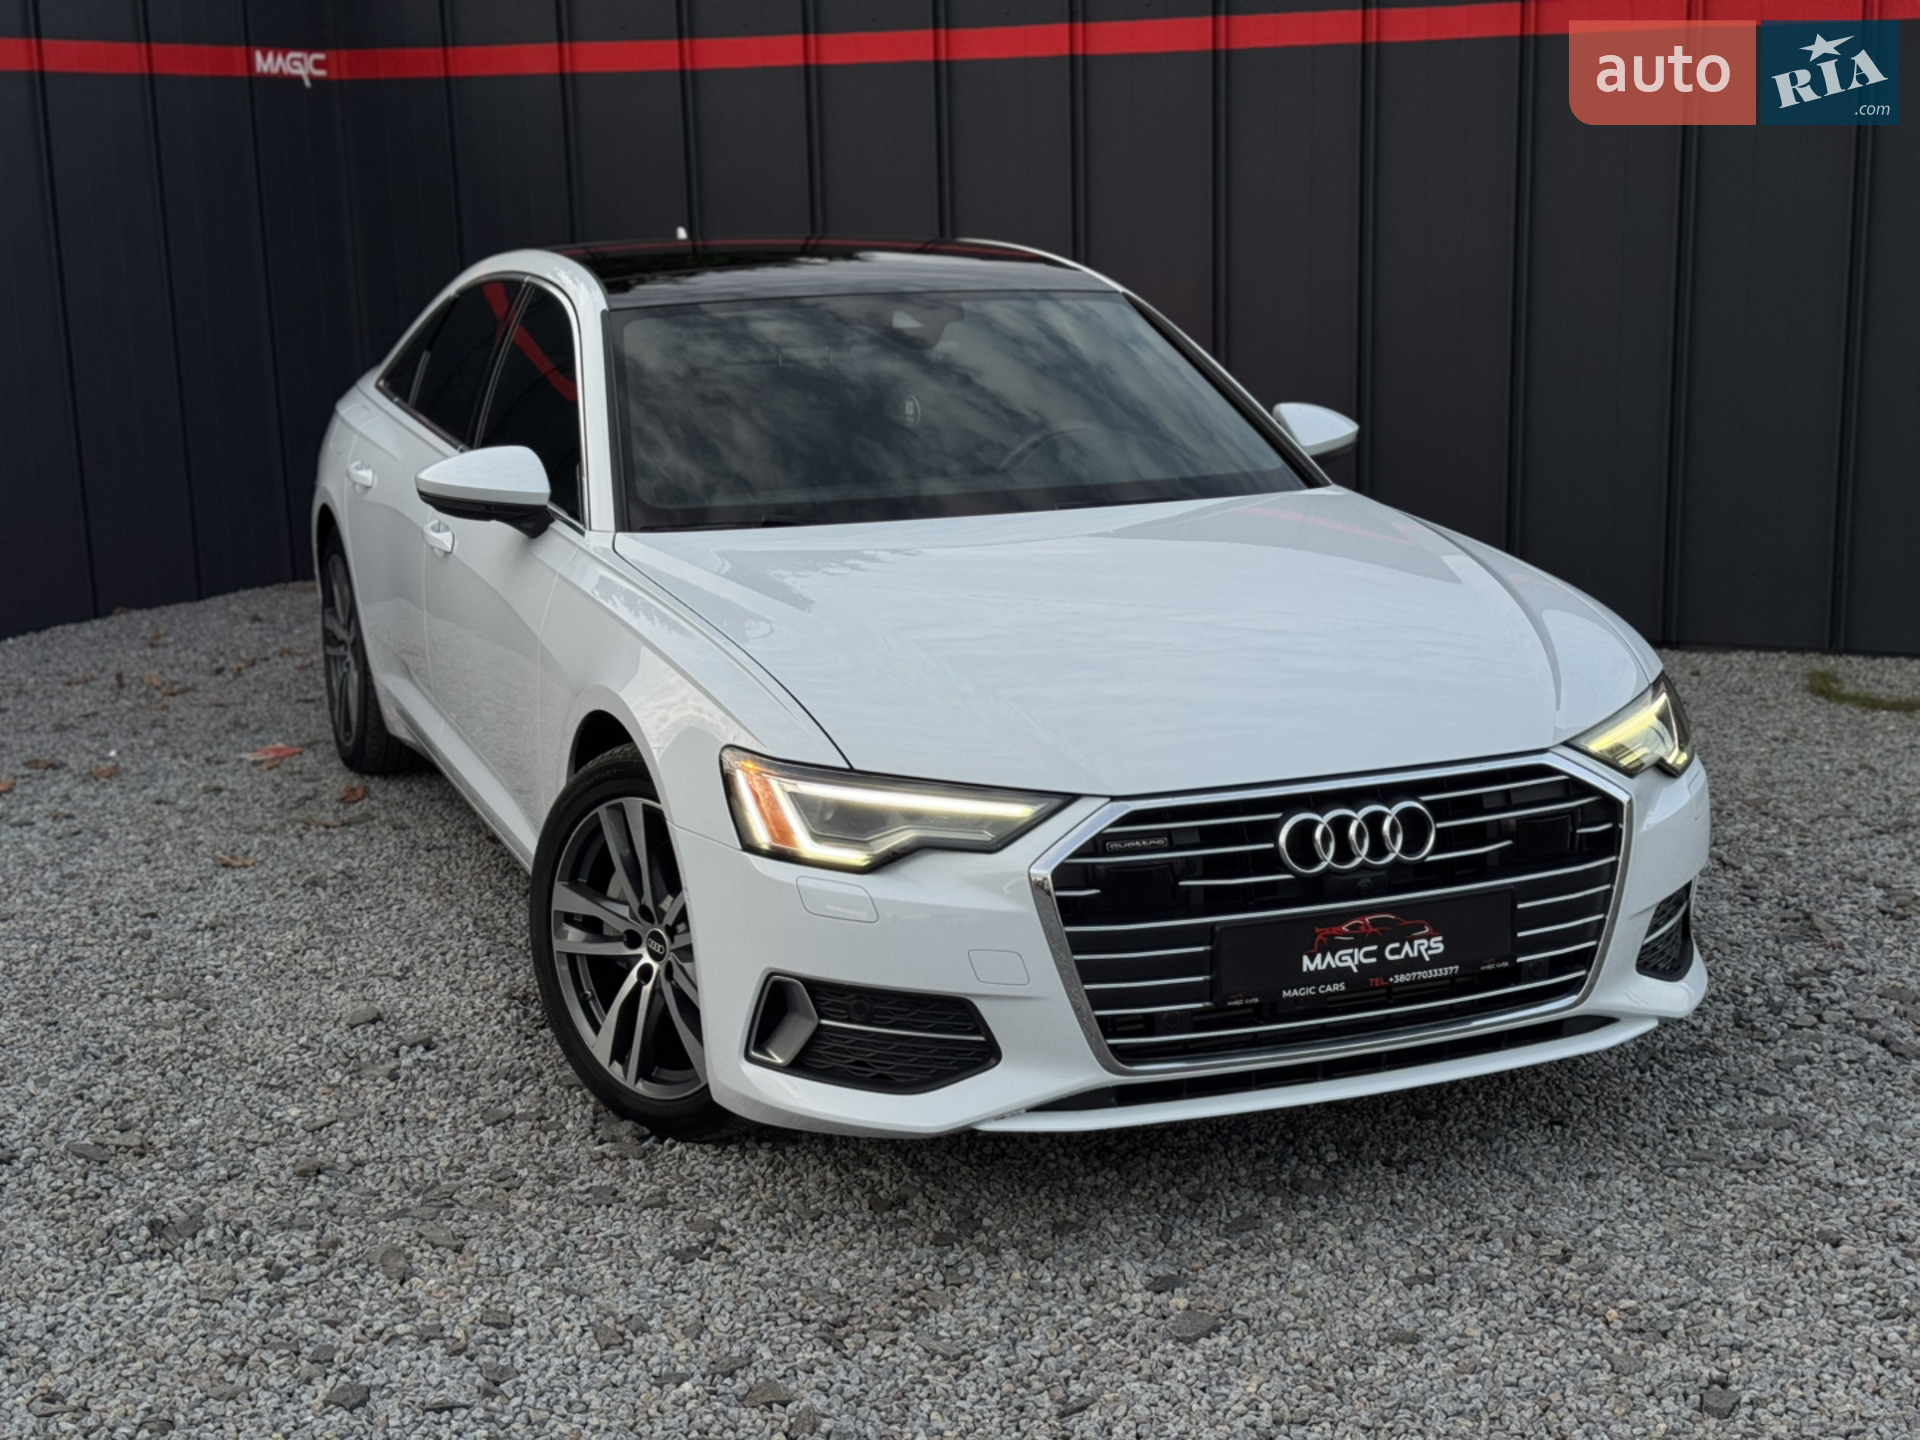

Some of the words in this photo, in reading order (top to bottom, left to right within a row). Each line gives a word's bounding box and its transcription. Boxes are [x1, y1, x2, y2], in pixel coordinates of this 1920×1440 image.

[255, 50, 328, 88] MAGIC
[1302, 945, 1379, 973] MAGIC
[1384, 936, 1445, 961] CARS
[1282, 985, 1316, 998] MAGIC
[1318, 982, 1346, 994] CARS
